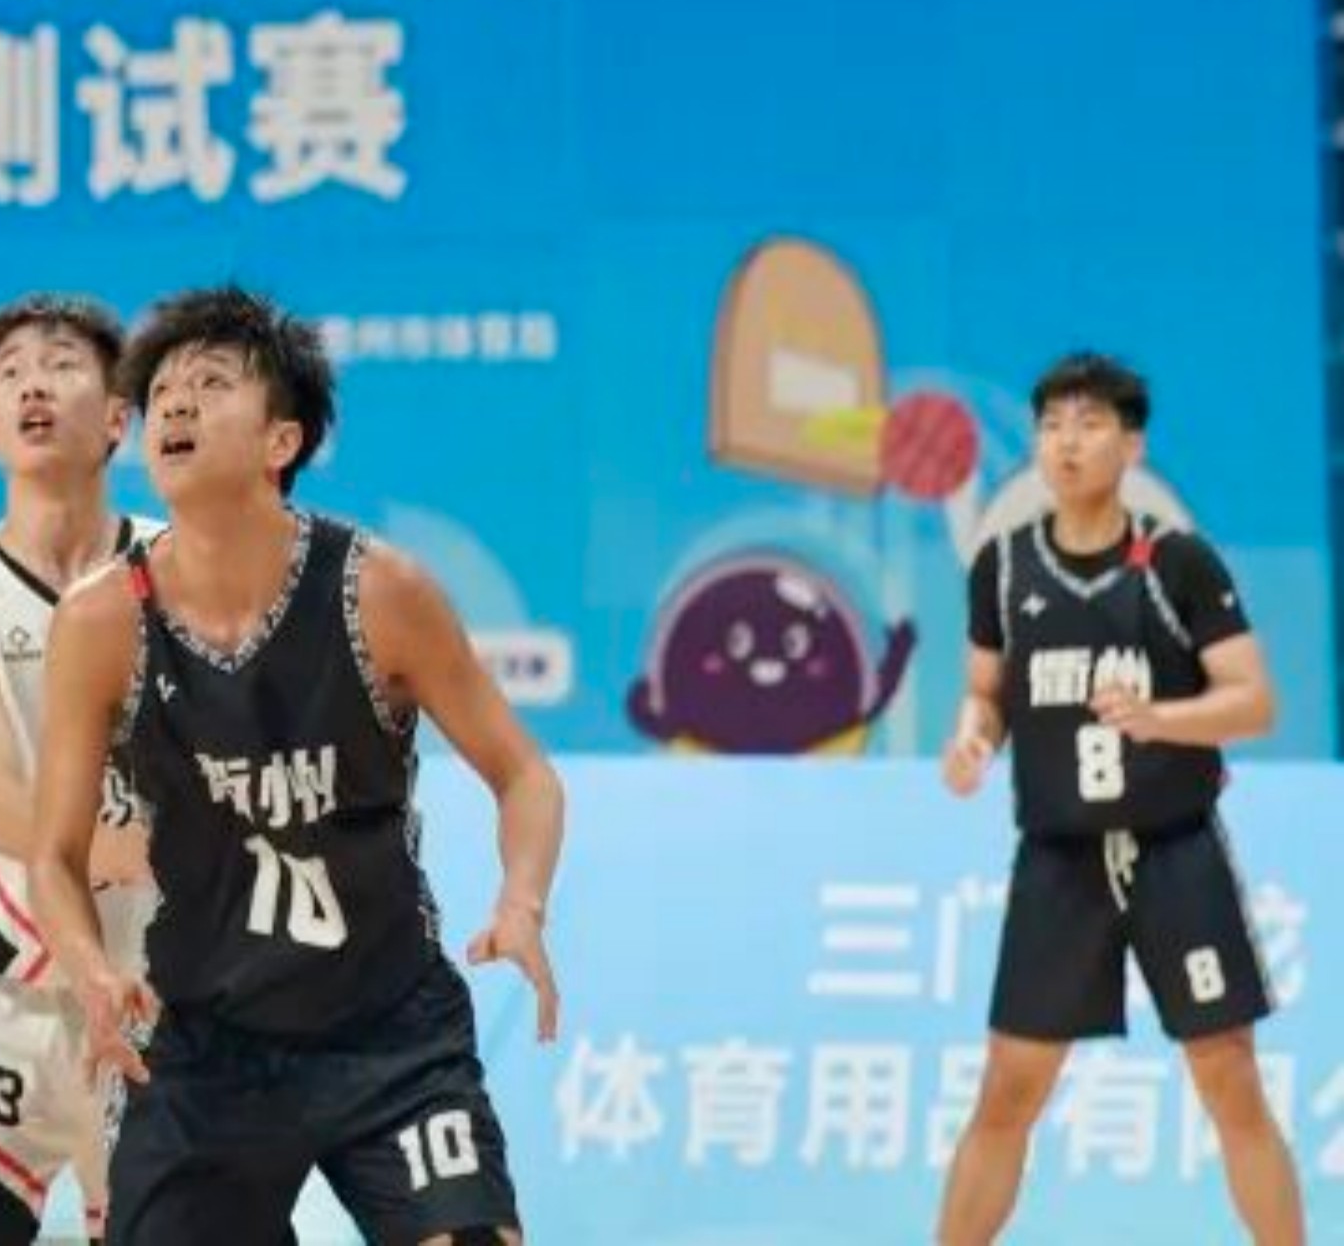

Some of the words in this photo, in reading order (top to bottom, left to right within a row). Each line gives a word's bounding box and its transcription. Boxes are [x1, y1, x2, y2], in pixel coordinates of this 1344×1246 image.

[1076, 724, 1124, 802] 8
[244, 832, 348, 951] 10
[1184, 945, 1226, 1003] 8
[398, 1109, 482, 1192] 10
